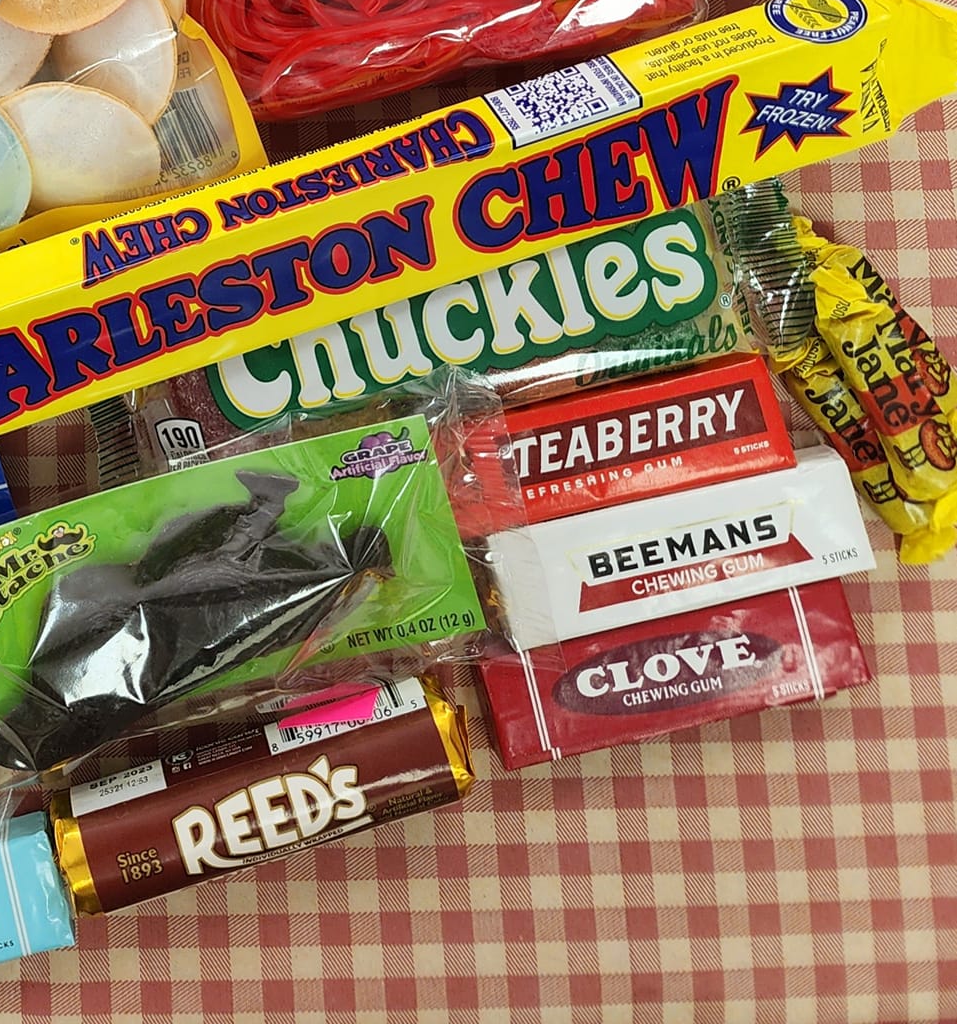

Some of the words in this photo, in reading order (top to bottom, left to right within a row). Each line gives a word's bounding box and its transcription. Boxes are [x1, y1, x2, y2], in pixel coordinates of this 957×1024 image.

[731, 29, 757, 43] does
[645, 47, 691, 67] peanuts,
[668, 56, 703, 73] facility
[788, 89, 828, 109] TRY
[756, 105, 837, 131] FROZEN!
[221, 110, 494, 232] CHARLESTON
[455, 75, 739, 252] CHEW
[80, 208, 211, 286] CHEW
[218, 220, 705, 418] Chuckles
[875, 318, 942, 417] Mary
[842, 339, 911, 426] Jane
[162, 424, 199, 450] 190
[513, 389, 744, 478] TEABERRY
[805, 388, 879, 463] Jane
[343, 439, 412, 464] GRAPE
[741, 440, 770, 454] STICKS
[331, 461, 386, 481] Artificial
[646, 456, 684, 473] GUM
[587, 515, 777, 579] BEEMANS
[830, 547, 858, 563] STICKS
[631, 562, 718, 595] CHEWING
[720, 552, 765, 578] GUM
[347, 631, 374, 649] NET
[375, 626, 395, 643] WT
[396, 622, 417, 639] 0.4
[419, 618, 437, 633] OZ
[439, 612, 460, 631] (12
[576, 634, 757, 697] CLOVE
[623, 683, 690, 707] CHEWING
[691, 676, 723, 695] GUM
[780, 678, 810, 694] STICKS
[173, 756, 369, 874] REED'S
[117, 847, 158, 868] Since
[122, 858, 163, 884] 1893
